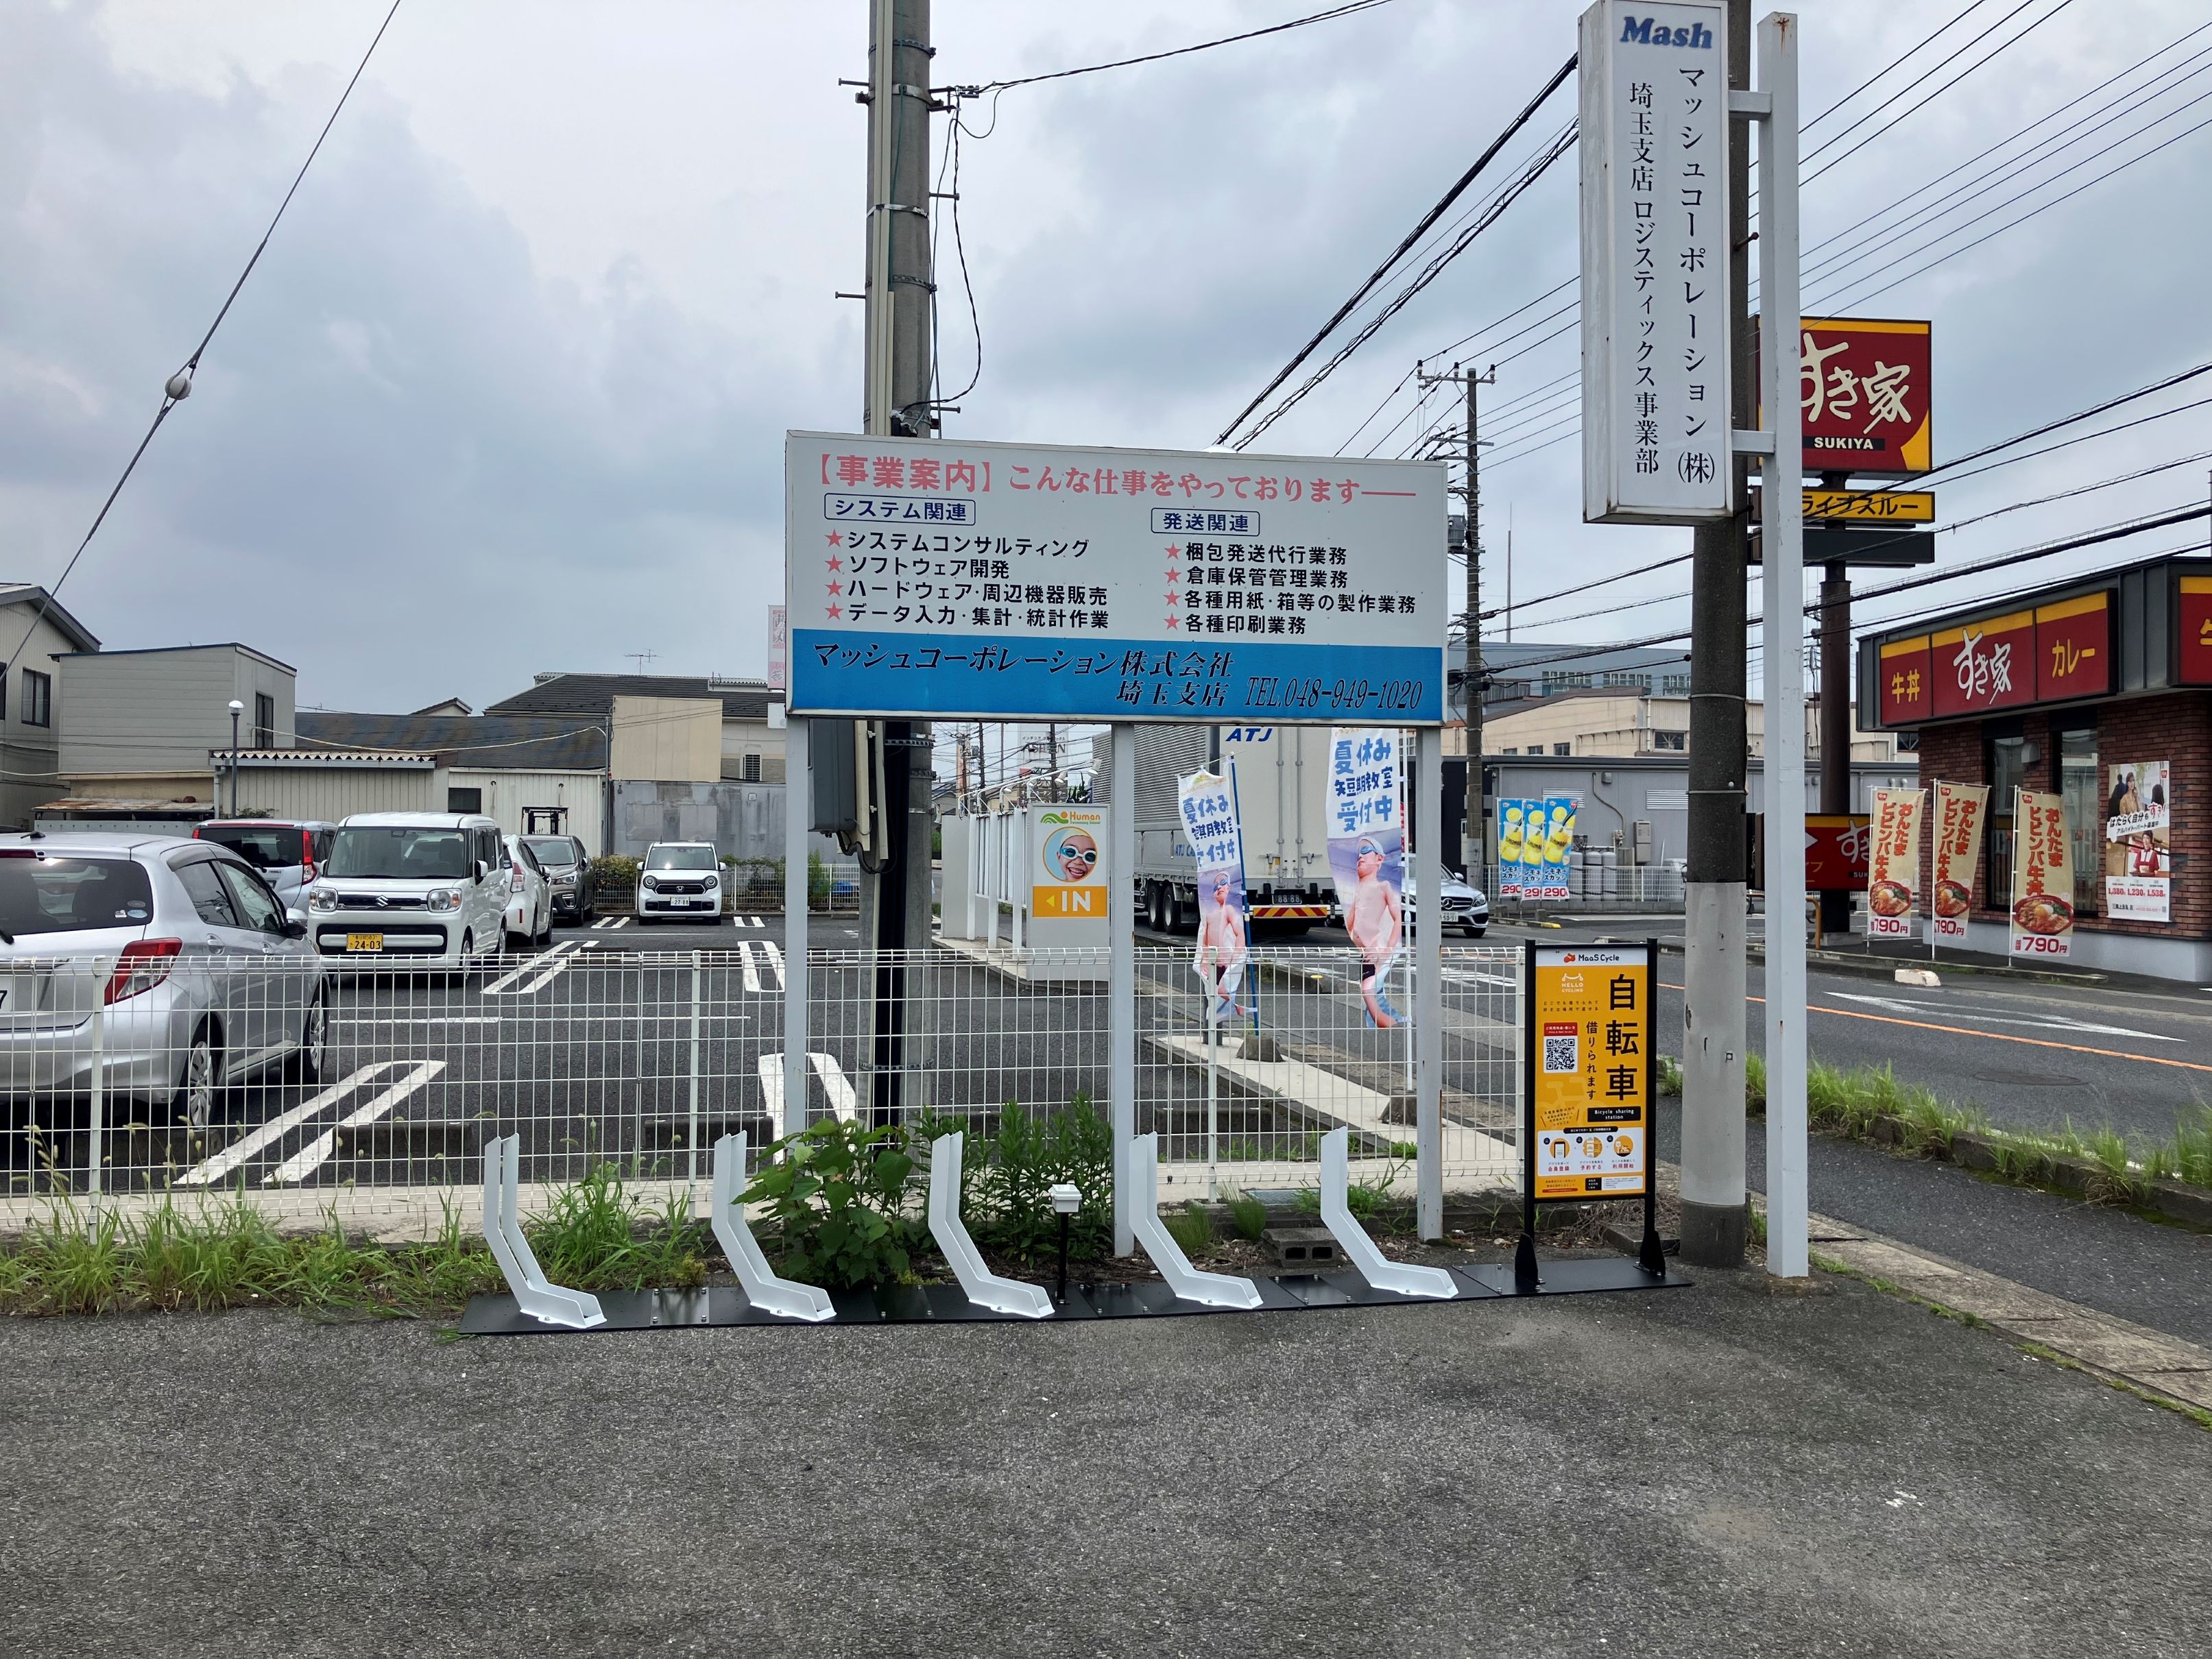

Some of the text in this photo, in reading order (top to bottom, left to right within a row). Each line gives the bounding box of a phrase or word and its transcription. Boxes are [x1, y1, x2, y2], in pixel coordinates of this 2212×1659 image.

[1620, 16, 1712, 49] Mash
[1801, 332, 1912, 435] すき家
[1814, 437, 1873, 450] SUKIYA
[835, 500, 966, 521] システム関連
[1164, 513, 1249, 532] 発送関連
[848, 532, 1089, 557] システムコンサルティング
[1186, 542, 1347, 565] 梱包発送代行業務
[850, 556, 1010, 579] ソフトウェア開発
[1187, 566, 1348, 588] 倉庫保管管理業務
[1185, 614, 1306, 634] 各種印刷業務
[1953, 628, 2012, 705] すき家
[2052, 638, 2095, 678] カレー
[1115, 681, 1230, 707] 埼玉支店
[1892, 668, 1920, 704] 牛丼
[1225, 728, 1273, 742] ATJ
[1334, 738, 1391, 775] 夏休み
[1334, 766, 1393, 797] 短期教室
[1070, 812, 1101, 821] Human
[1183, 795, 1229, 825] 夏休み
[1338, 795, 1393, 832] 受付中
[1894, 803, 1914, 856] おんたま
[1955, 800, 1977, 856] おんたま
[2045, 808, 2063, 868] おんたま
[2026, 806, 2045, 896] ビビンバ牛丼
[1062, 891, 1090, 911] IN
[1524, 888, 1541, 897] 29
[1600, 954, 1620, 962] Cycle
[2023, 936, 2067, 954] 790円
[1605, 973, 1639, 1101] 自転車
[1586, 1021, 1598, 1100] 借りられます
